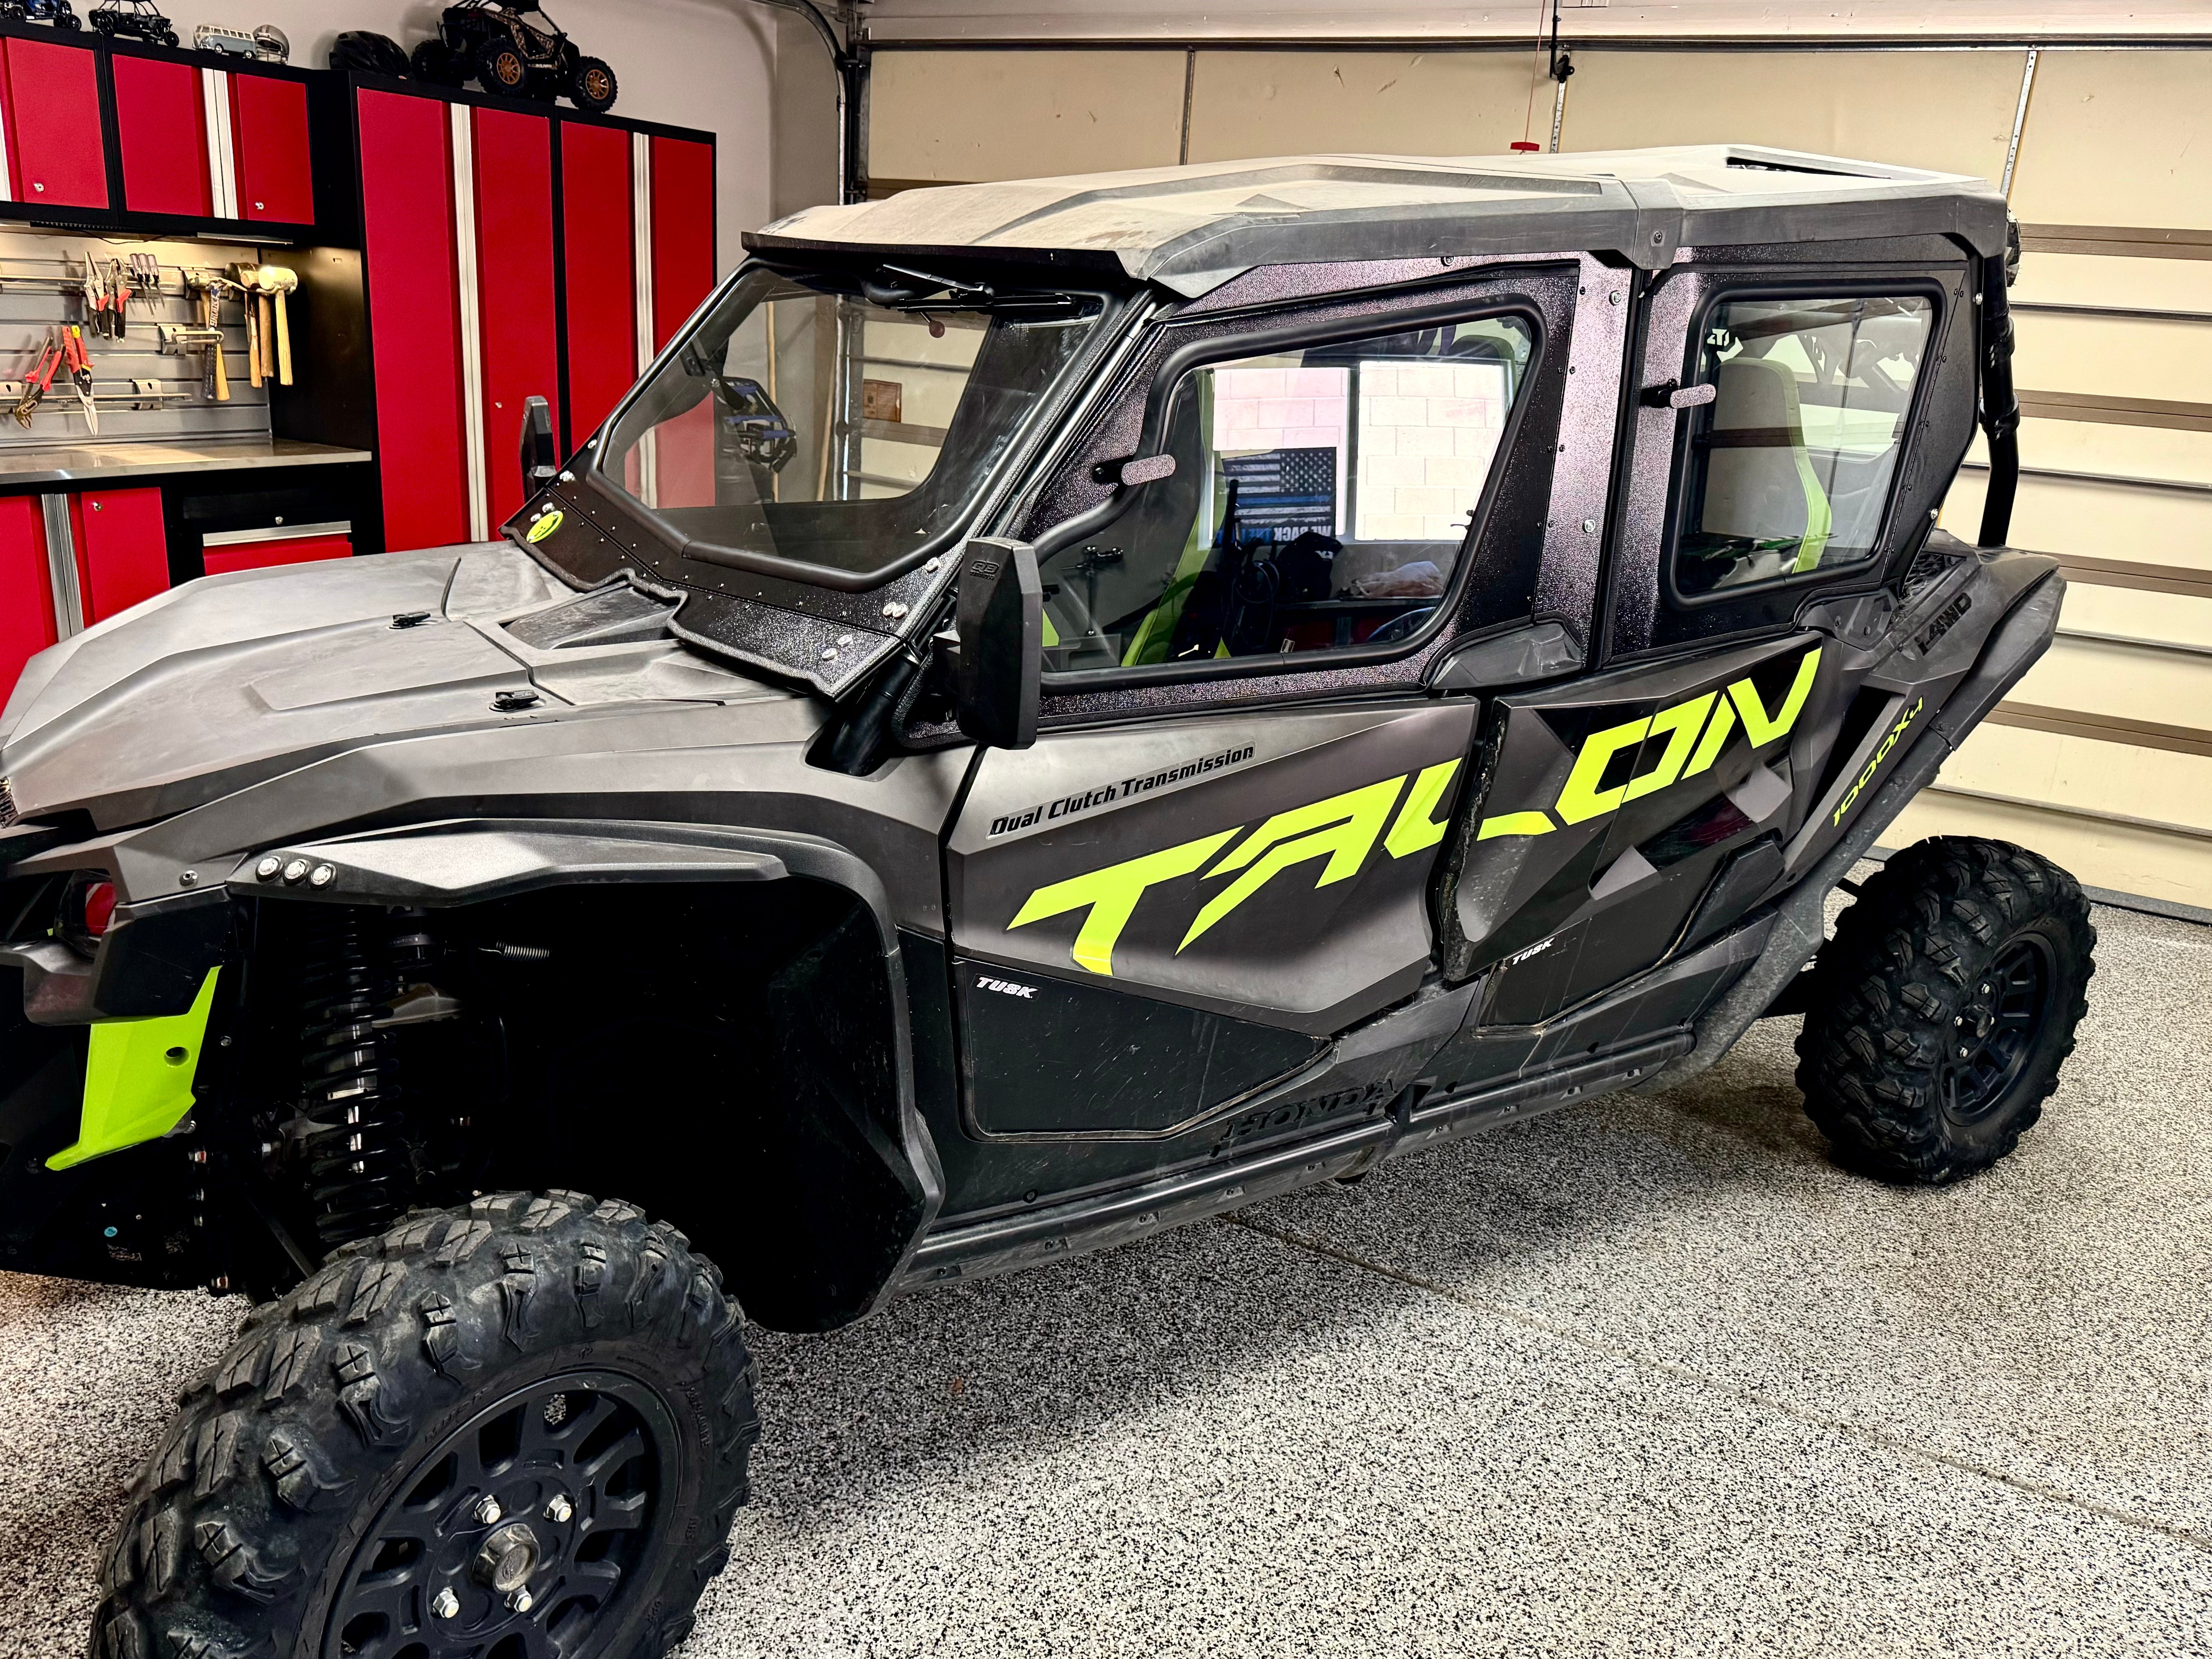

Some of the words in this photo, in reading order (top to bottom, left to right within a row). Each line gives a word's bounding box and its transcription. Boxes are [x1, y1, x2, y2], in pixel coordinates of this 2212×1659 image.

[990, 805, 1043, 835] Dual
[1048, 785, 1116, 819] Clutch
[1121, 747, 1254, 797] Transmission
[1006, 647, 1823, 976] TALON
[1512, 938, 1555, 965] TUSK
[976, 977, 1038, 998] TUSK
[1220, 1078, 1398, 1141] HONDA
